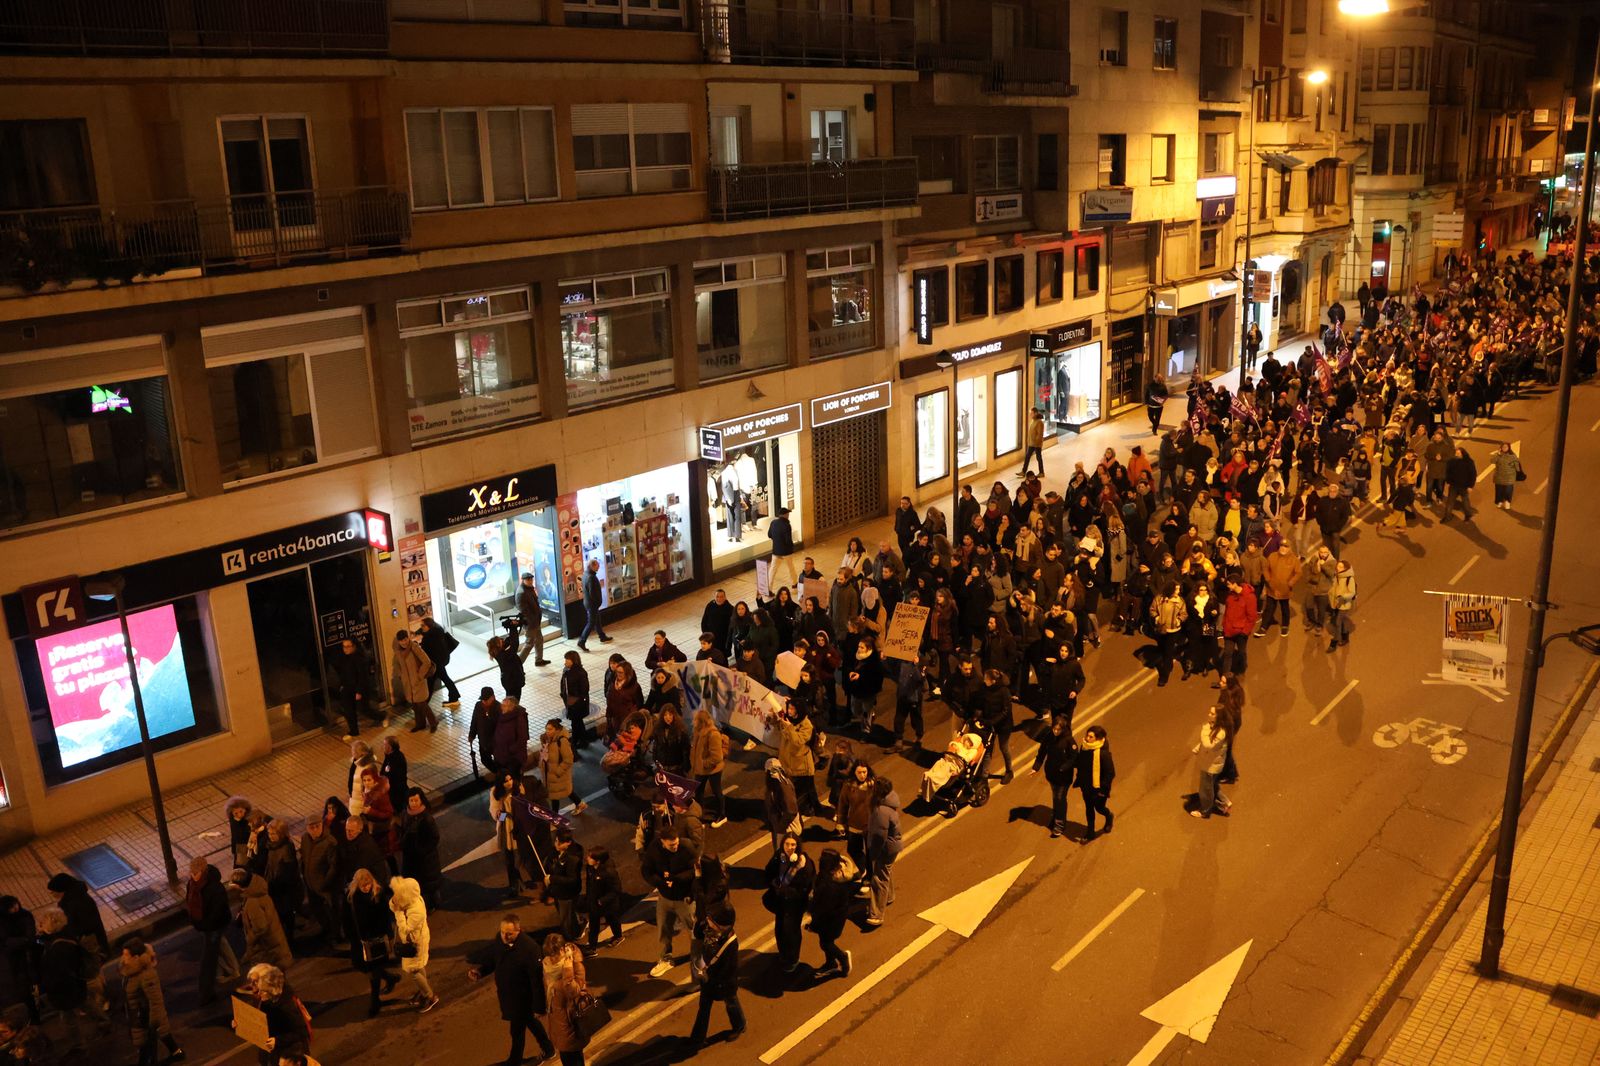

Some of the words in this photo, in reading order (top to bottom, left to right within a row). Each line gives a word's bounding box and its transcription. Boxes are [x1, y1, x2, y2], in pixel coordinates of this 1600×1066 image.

[1058, 328, 1085, 341] FLORENTINO
[823, 400, 839, 412] LION
[840, 397, 850, 407] OF
[851, 390, 879, 405] PORCHES
[723, 424, 742, 437] LION
[743, 420, 754, 432] OF
[755, 412, 789, 428] PORCHES
[467, 485, 488, 512] X
[489, 490, 502, 506] &
[504, 477, 520, 503] L
[448, 511, 477, 524] Teléfonos
[478, 505, 501, 517] Móviles
[507, 496, 539, 508] Accesorios
[250, 526, 355, 566] renta4banco
[1455, 608, 1493, 624] STOCK
[52, 655, 105, 683] gratis
[54, 681, 76, 696] tu
